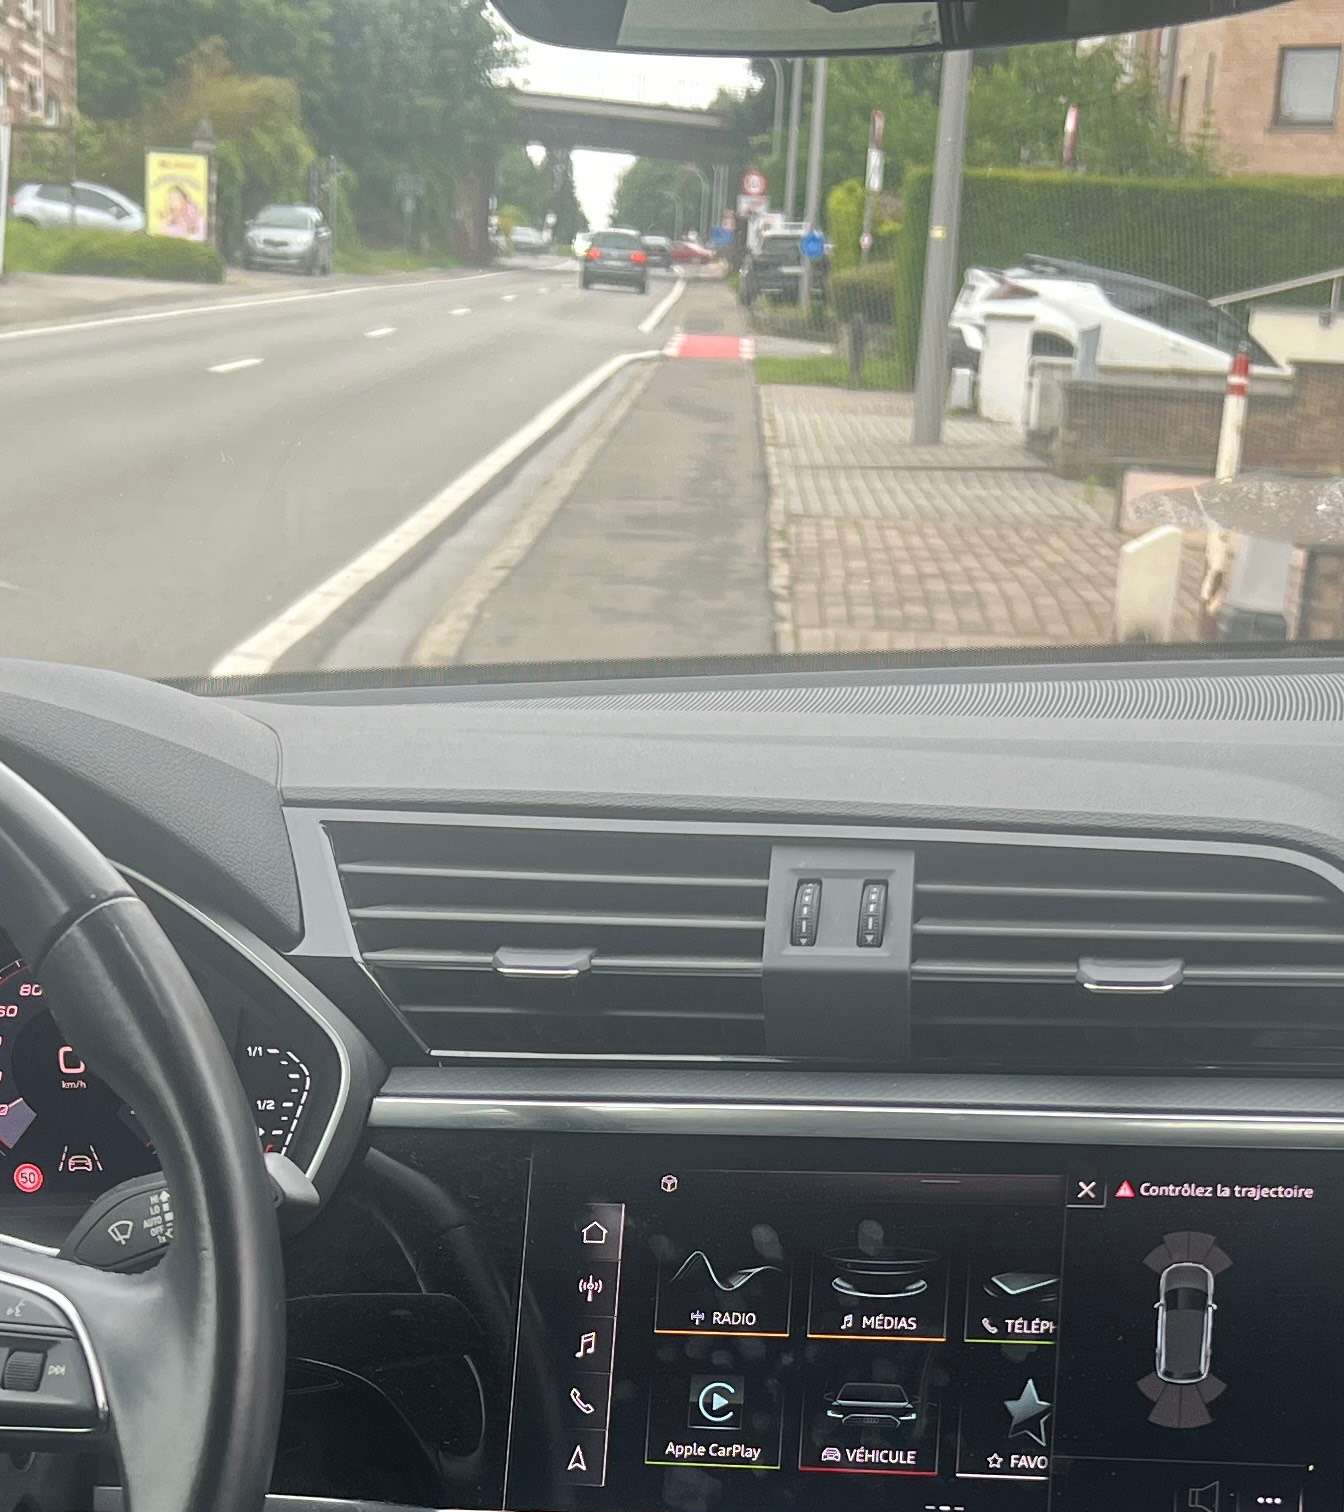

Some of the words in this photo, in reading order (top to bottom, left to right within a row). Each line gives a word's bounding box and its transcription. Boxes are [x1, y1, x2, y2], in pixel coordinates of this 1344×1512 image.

[19, 984, 43, 997] 80
[247, 1046, 263, 1057] 1/1
[61, 1080, 87, 1088] km/h
[256, 1100, 275, 1110] 1/2
[20, 1172, 36, 1184] 50
[1140, 1181, 1213, 1198] Contrôlez
[1216, 1183, 1231, 1198] la
[1233, 1184, 1314, 1201] trajectoire
[712, 1311, 757, 1327] RADIO
[862, 1312, 917, 1331] MÉDIAS
[664, 1441, 706, 1460] Apple
[709, 1442, 762, 1461] CarPlay
[846, 1445, 917, 1465] VÉHICULE
